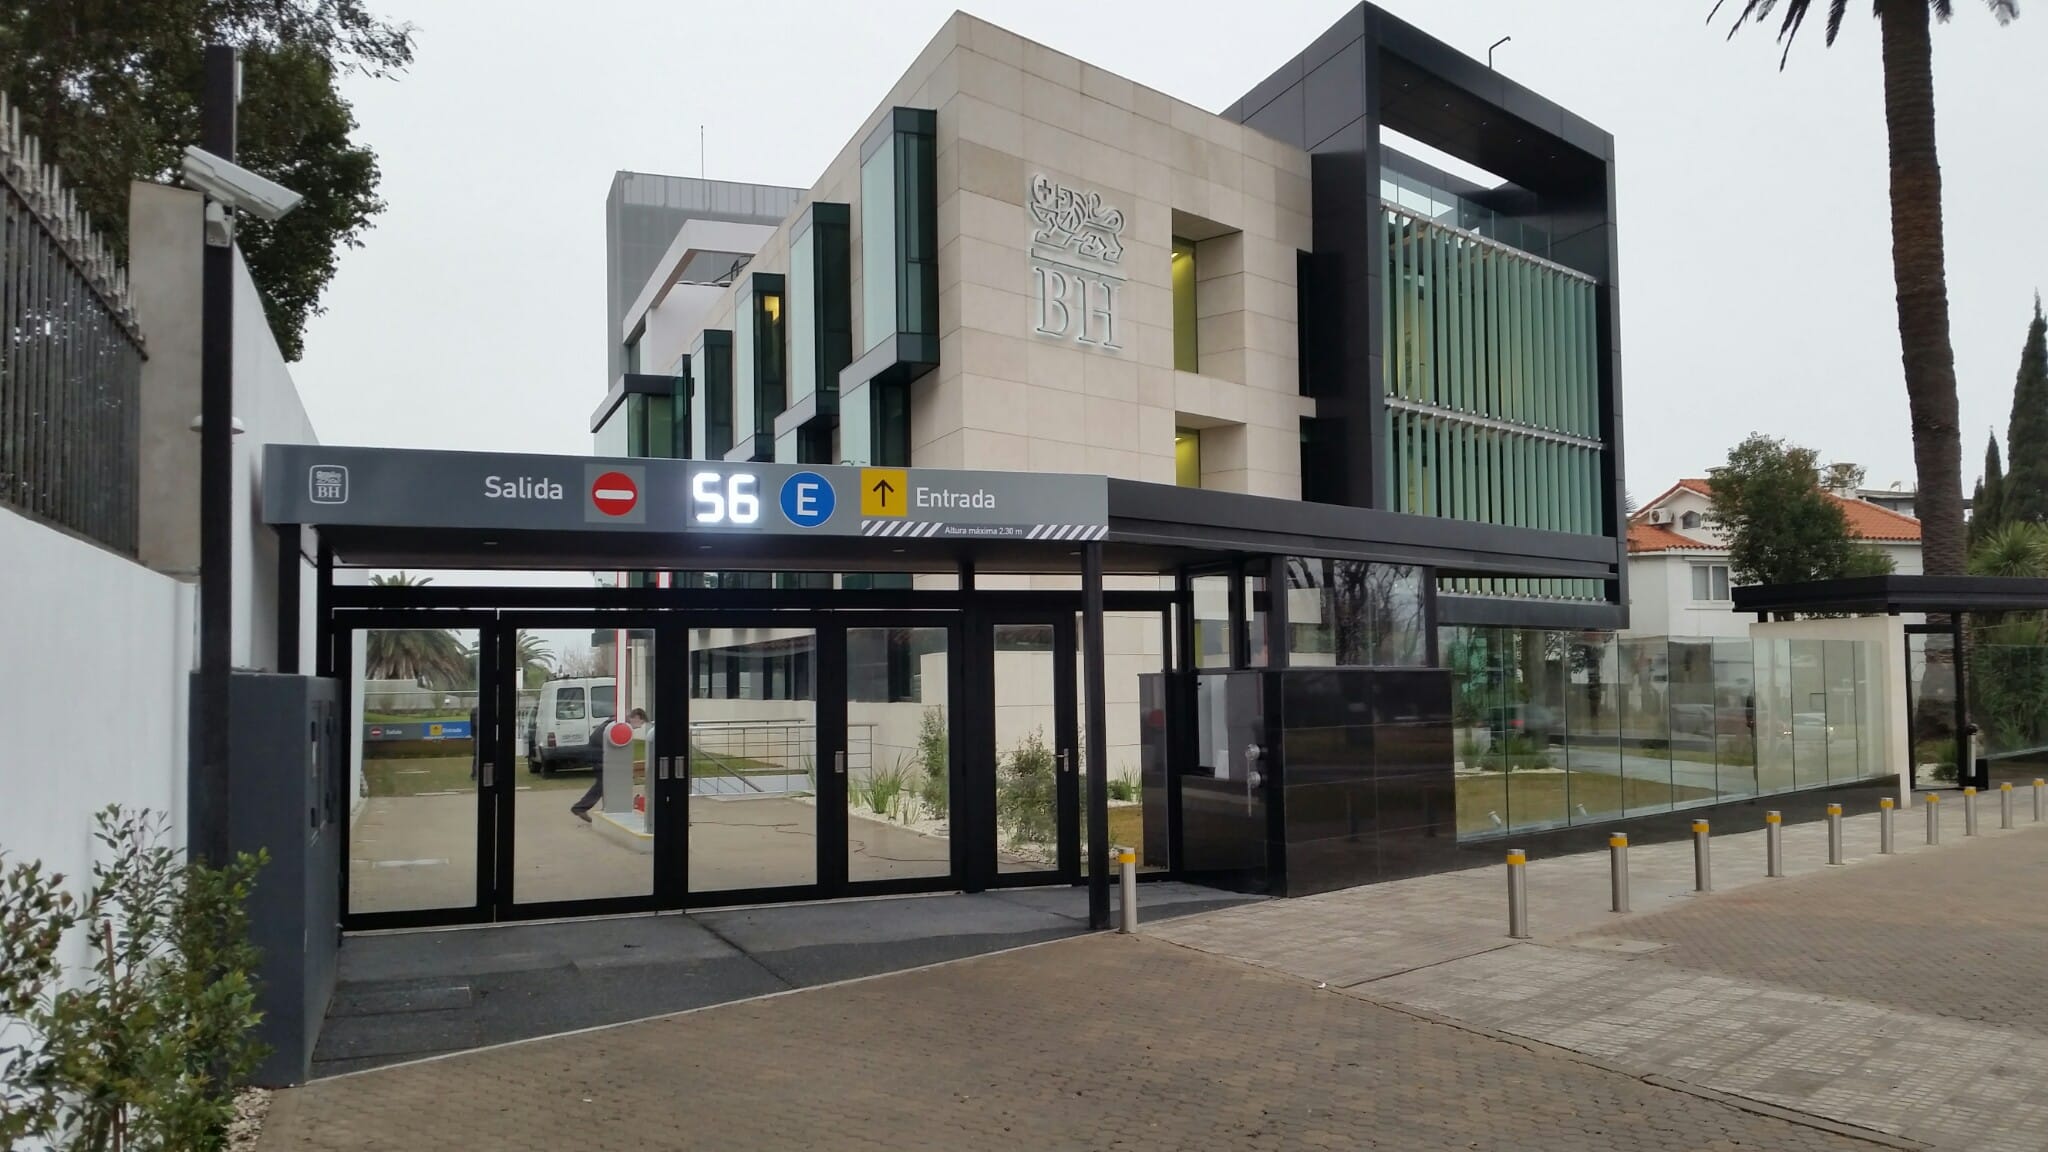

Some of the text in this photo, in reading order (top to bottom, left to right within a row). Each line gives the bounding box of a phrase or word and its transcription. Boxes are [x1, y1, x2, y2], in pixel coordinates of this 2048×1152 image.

[1035, 267, 1124, 349] BH
[317, 486, 341, 498] BH
[484, 475, 563, 500] Salida
[692, 472, 760, 524] 56
[797, 483, 819, 516] E
[916, 487, 996, 509] Entrada
[944, 526, 967, 535] Altura
[968, 527, 998, 536] máxima
[999, 527, 1014, 535] 2.30
